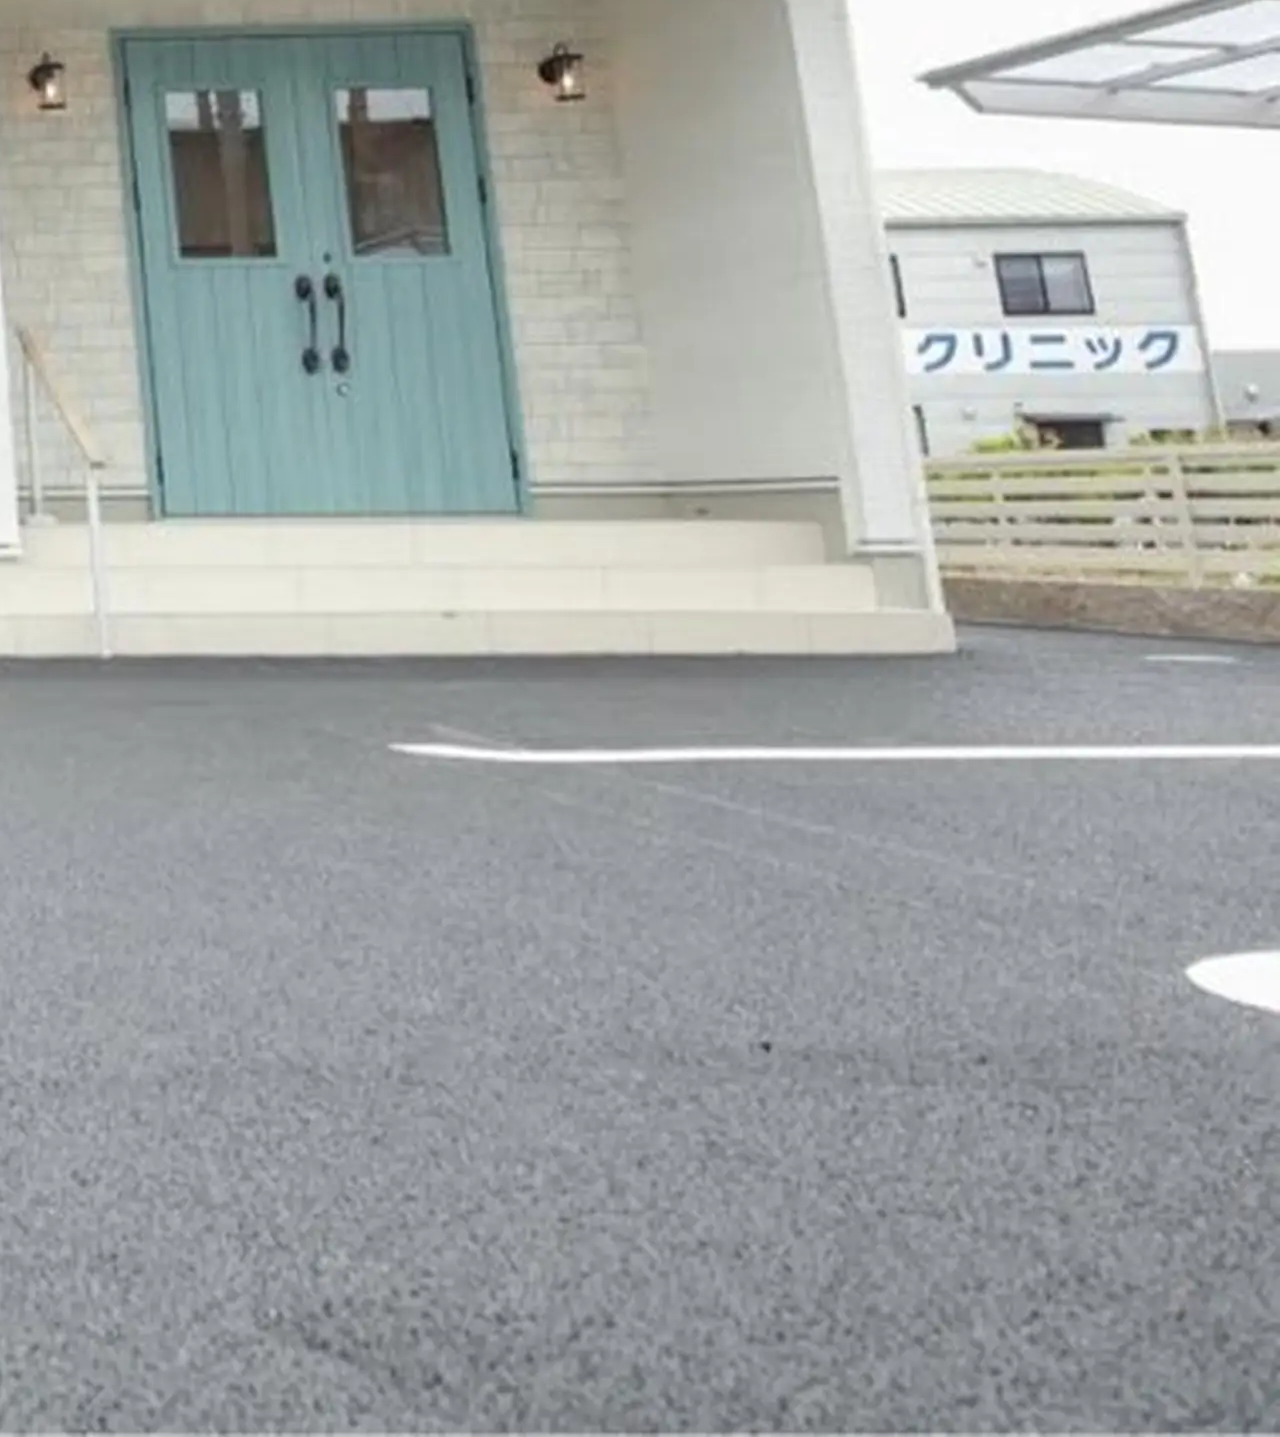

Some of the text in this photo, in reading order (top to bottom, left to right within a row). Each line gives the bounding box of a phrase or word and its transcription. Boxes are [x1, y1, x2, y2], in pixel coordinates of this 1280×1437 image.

[916, 329, 1180, 372] クリニック
